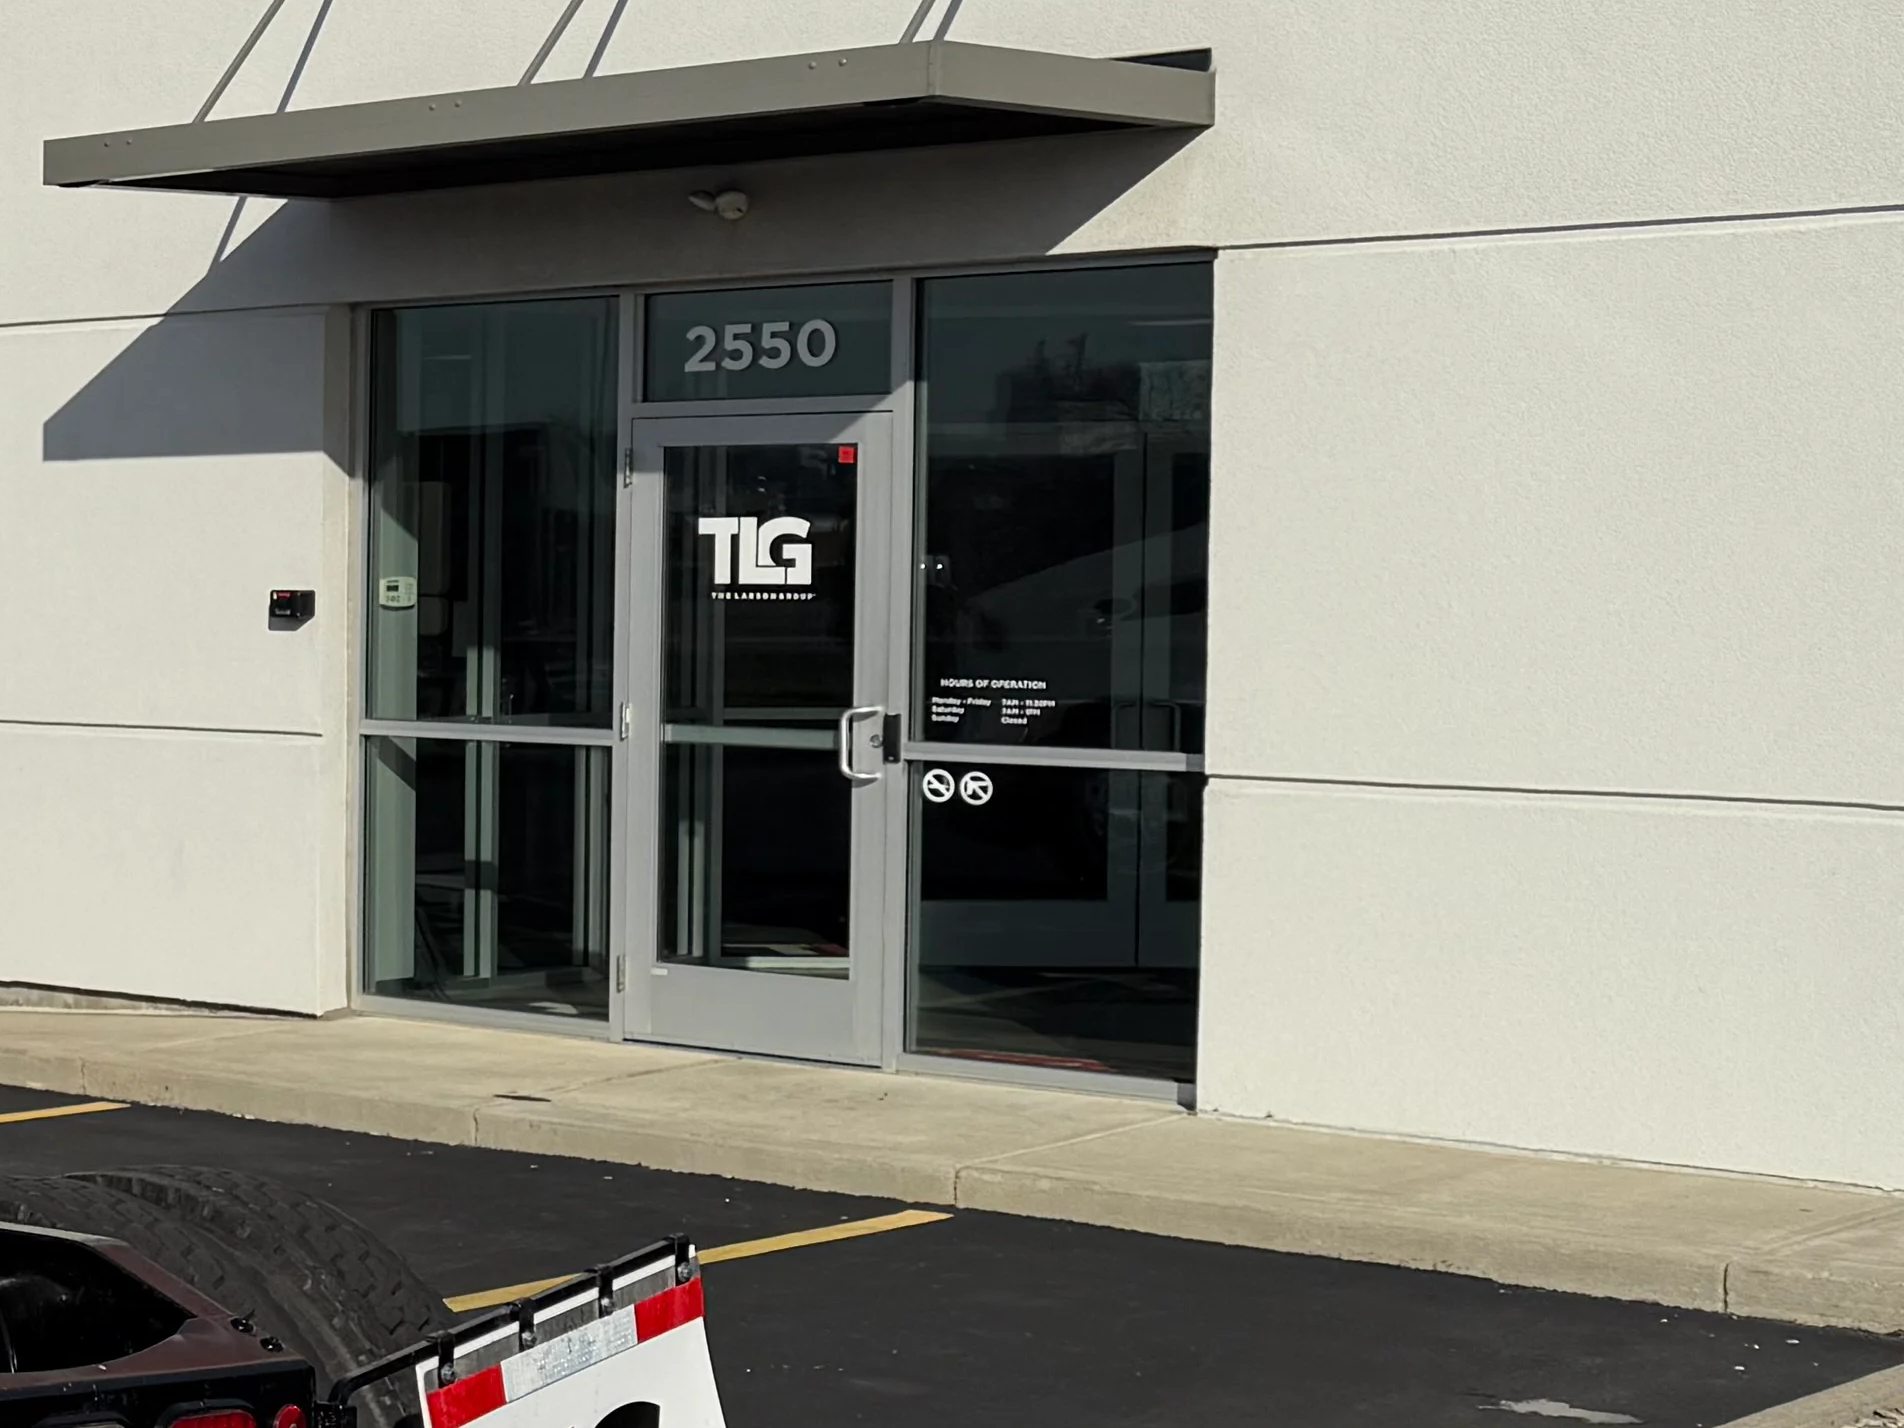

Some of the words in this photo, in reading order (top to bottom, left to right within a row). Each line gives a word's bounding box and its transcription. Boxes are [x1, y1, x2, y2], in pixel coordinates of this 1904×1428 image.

[684, 319, 836, 372] 2550
[698, 516, 812, 585] TLG
[940, 678, 973, 689] HOURS
[975, 679, 989, 688] OF
[991, 679, 1047, 690] OPERATION
